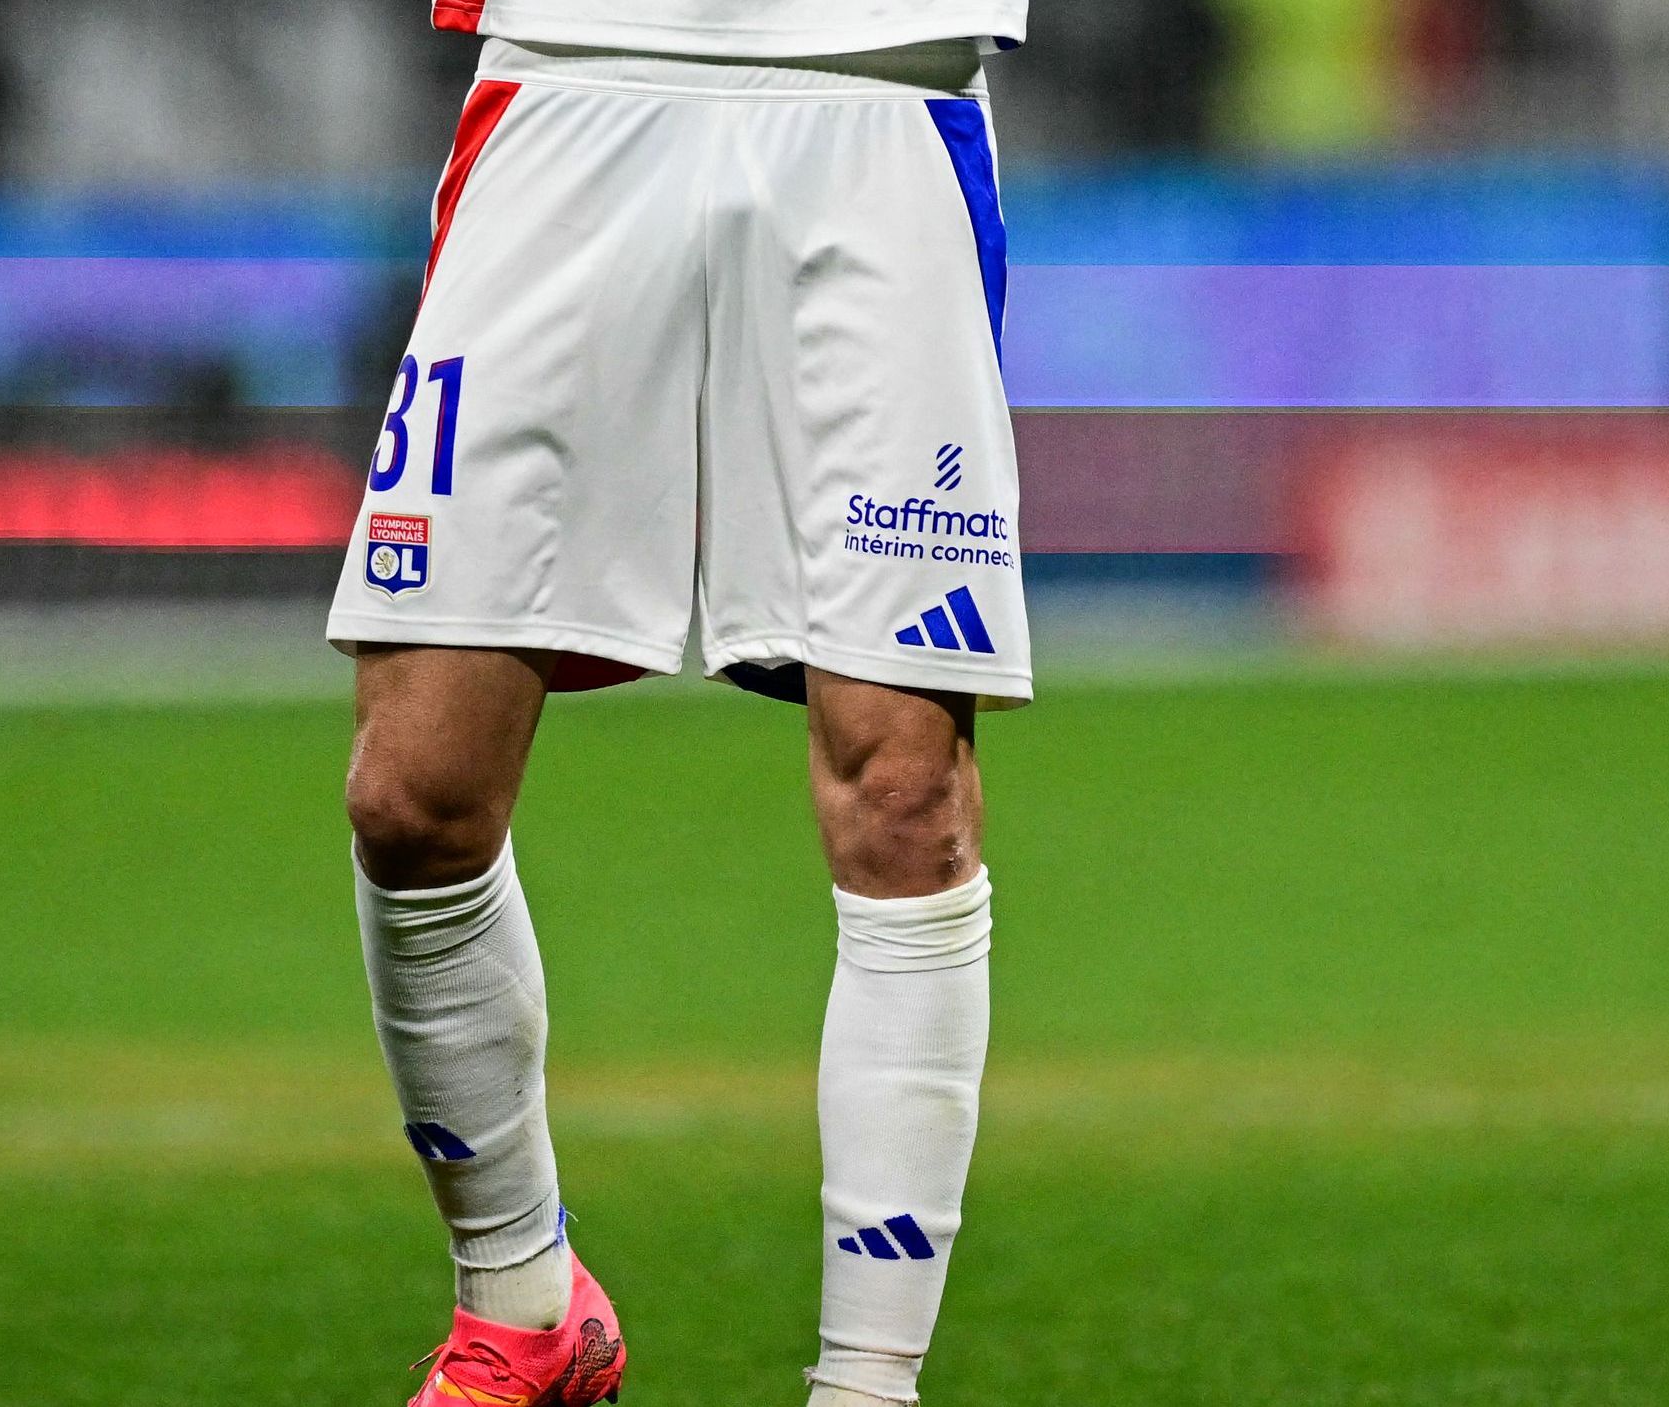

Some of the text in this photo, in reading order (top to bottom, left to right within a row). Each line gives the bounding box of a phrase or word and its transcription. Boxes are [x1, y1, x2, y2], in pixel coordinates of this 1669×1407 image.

[369, 354, 464, 496] 31
[371, 528, 424, 542] LYONNAIS
[372, 518, 425, 531] OLYMPIQUE
[370, 545, 421, 582] OL
[844, 529, 1015, 570] intérim connec
